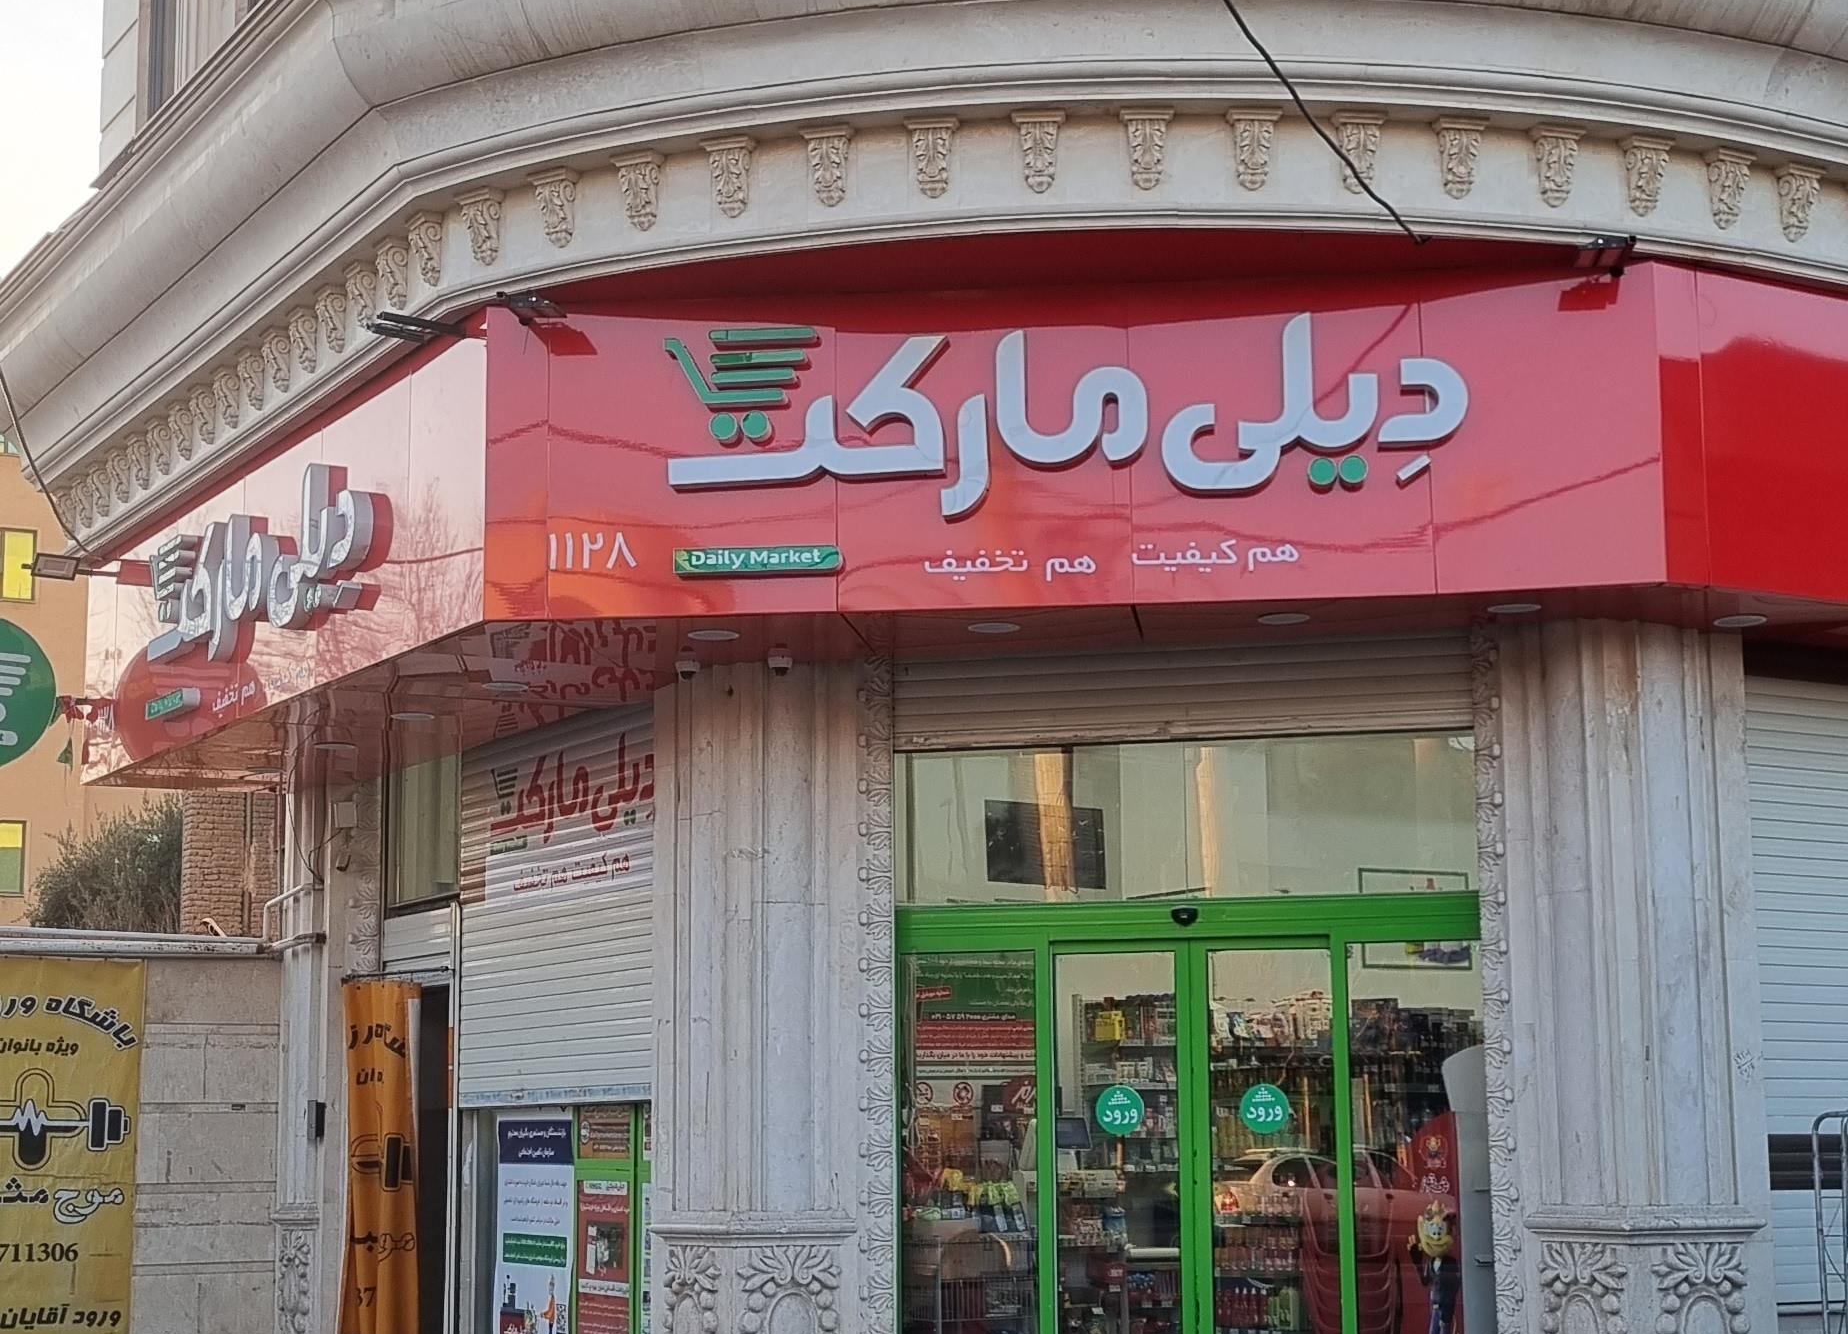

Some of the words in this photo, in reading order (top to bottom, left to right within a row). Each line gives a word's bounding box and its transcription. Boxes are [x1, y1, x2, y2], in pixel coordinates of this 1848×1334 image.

[665, 328, 1149, 522] مارکت
[548, 532, 638, 571] ۱۱۲۸
[691, 550, 745, 570] Daily
[749, 548, 822, 566] Market
[924, 548, 1030, 582] تخفیف
[1130, 538, 1239, 572] کیفیت
[1246, 542, 1300, 572] هم
[1045, 553, 1098, 582] هم
[147, 514, 268, 663] مارکت
[241, 680, 256, 706] هم
[490, 750, 590, 845] مارکت
[0, 995, 38, 1019] ور
[44, 995, 139, 1051] باشگاه
[45, 1036, 80, 1056] ویژه
[1102, 1108, 1138, 1125] ورود
[1246, 1105, 1283, 1123] ورود
[0, 1176, 50, 1205] مث
[53, 1187, 125, 1225] موج
[0, 1303, 71, 1331] آقایان
[72, 1309, 122, 1328] ورود
